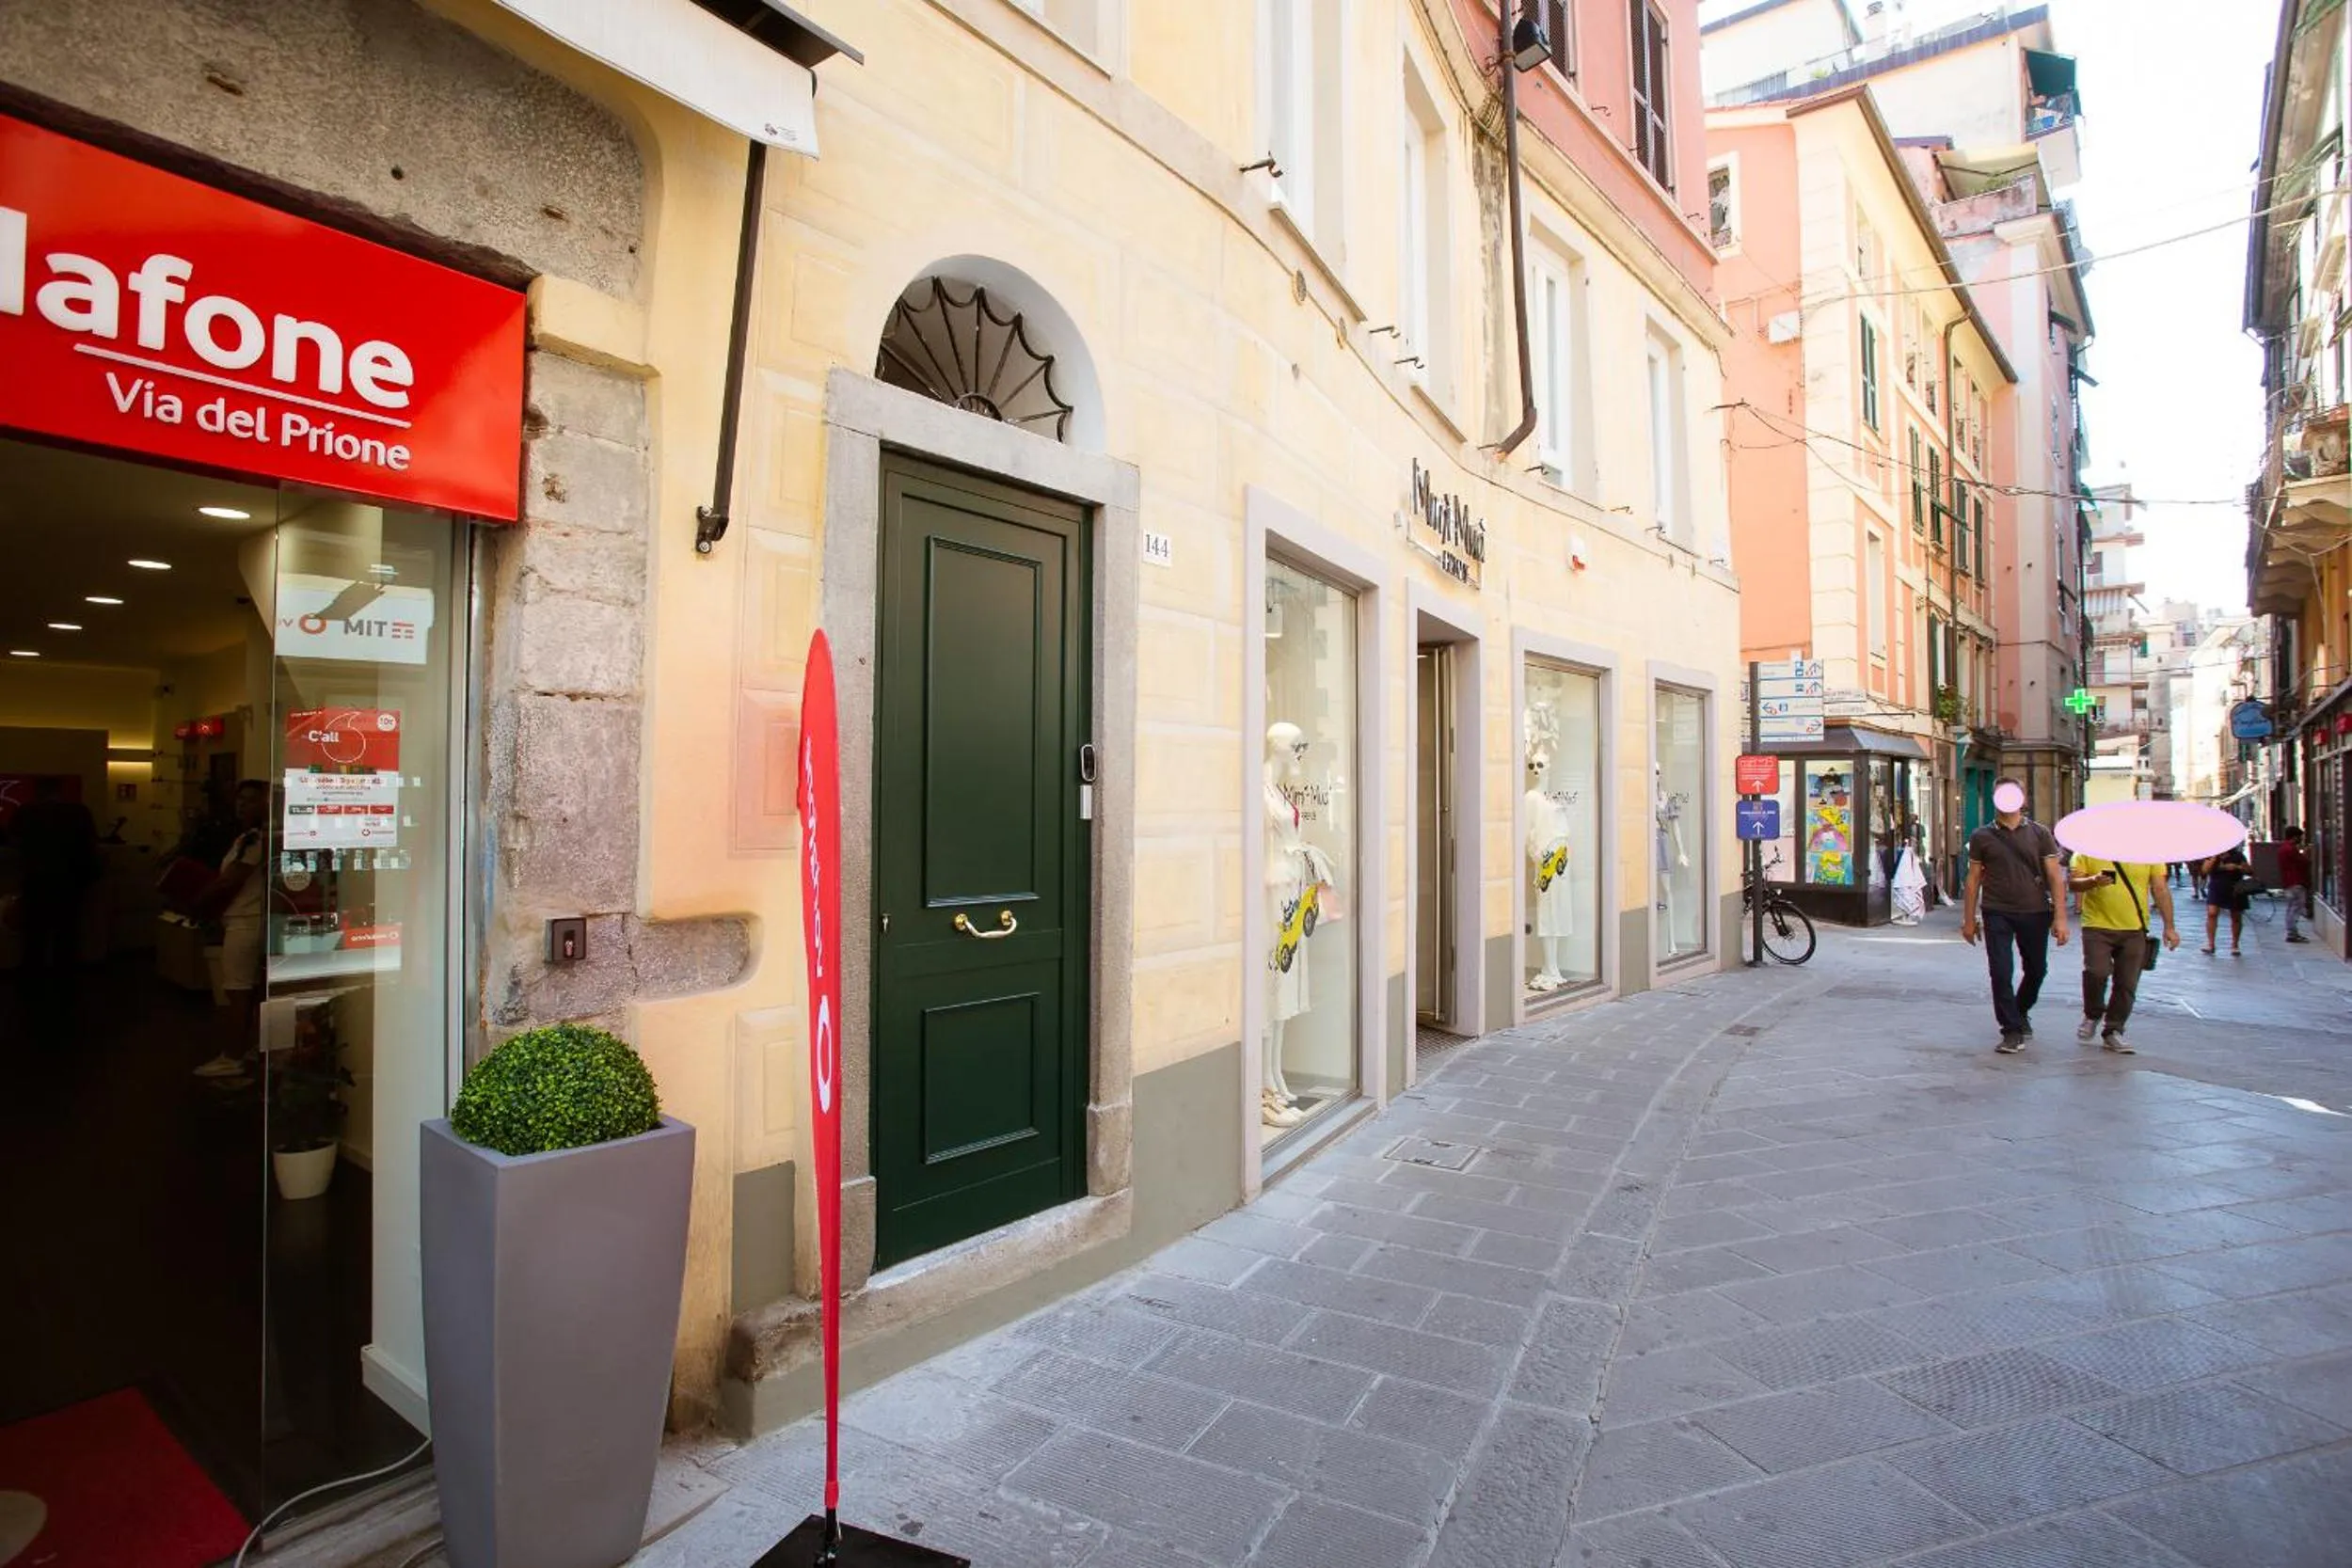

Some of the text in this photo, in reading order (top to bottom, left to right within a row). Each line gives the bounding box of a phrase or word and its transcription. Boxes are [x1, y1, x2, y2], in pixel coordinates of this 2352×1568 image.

[105, 372, 411, 470] Via del Prione
[1145, 533, 1168, 558] 144
